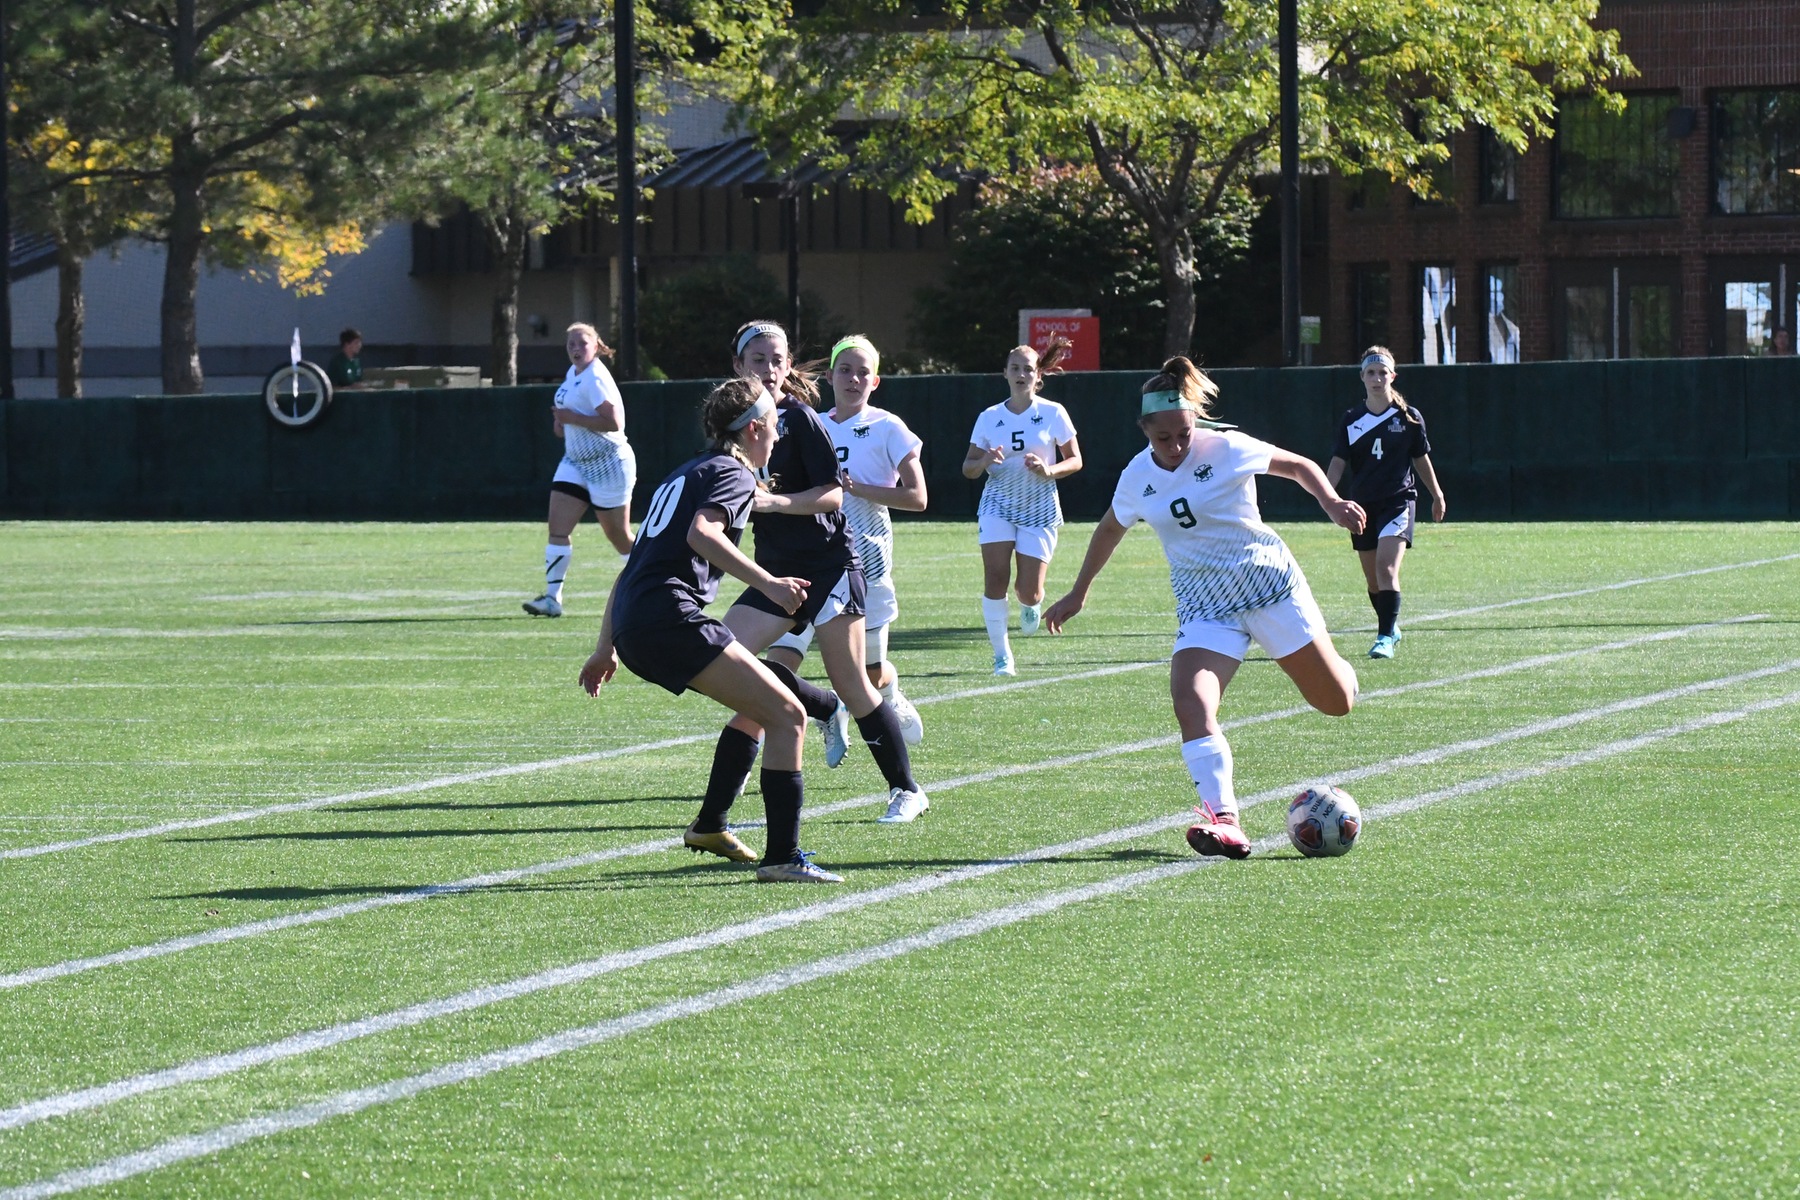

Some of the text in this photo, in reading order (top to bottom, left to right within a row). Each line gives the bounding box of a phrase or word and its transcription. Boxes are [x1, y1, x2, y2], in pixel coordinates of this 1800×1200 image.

[1036, 322, 1080, 332] SCHOOL OF
[1011, 431, 1025, 452] 5
[1371, 438, 1384, 460] 4
[1170, 497, 1197, 529] 9
